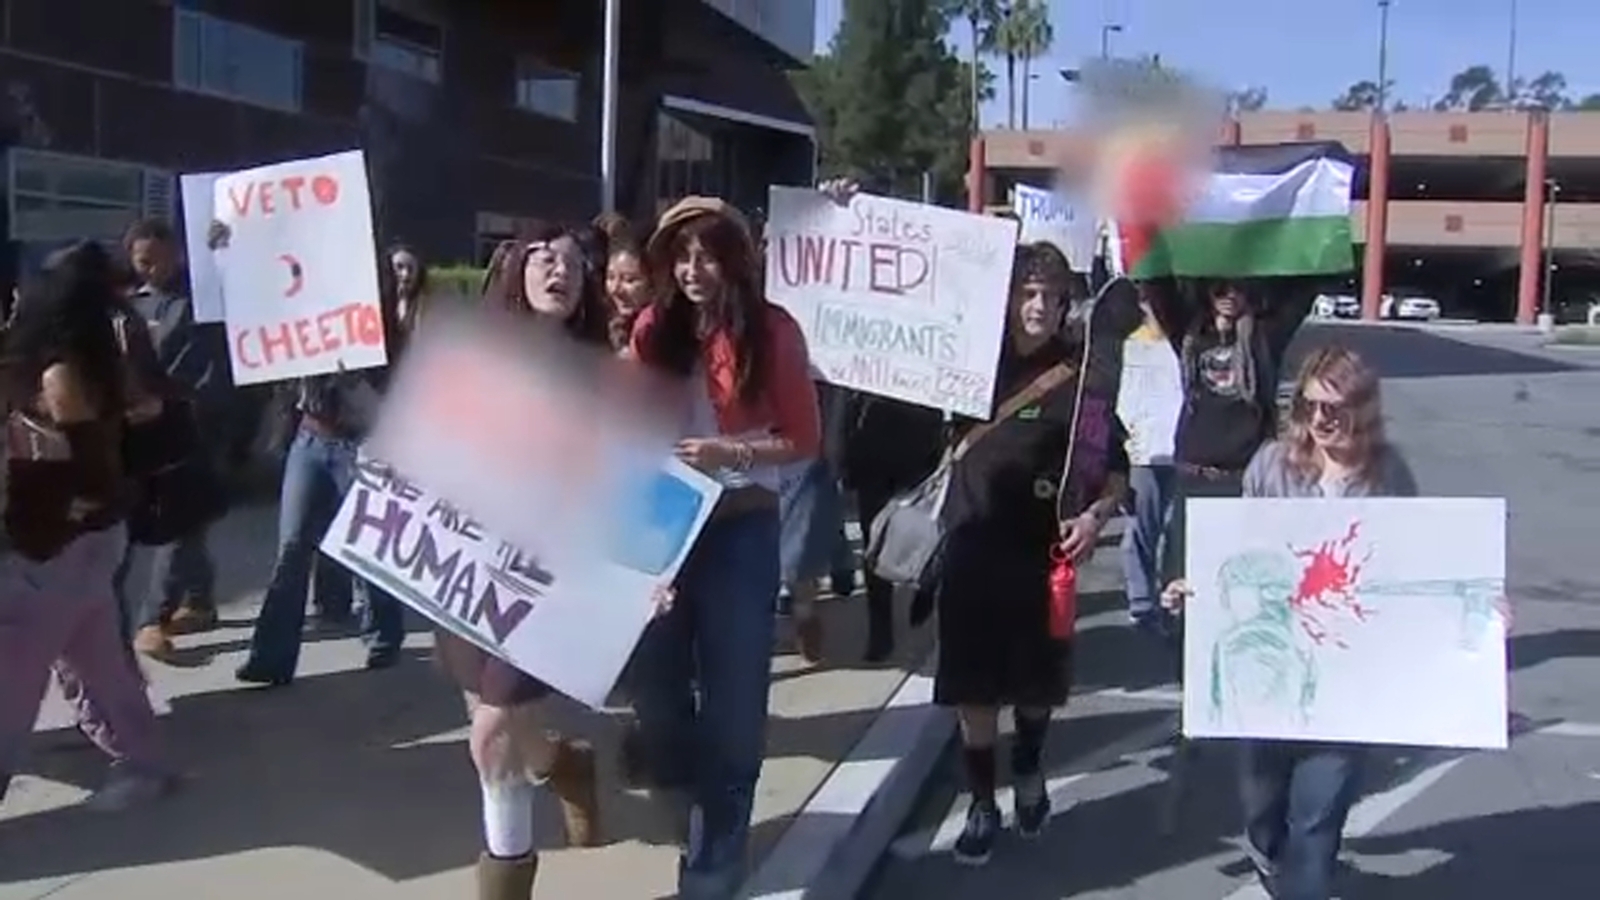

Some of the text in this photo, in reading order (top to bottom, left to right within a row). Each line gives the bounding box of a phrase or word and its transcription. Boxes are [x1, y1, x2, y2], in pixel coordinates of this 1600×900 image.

[229, 175, 338, 216] VETO
[853, 203, 932, 241] States
[779, 234, 929, 295] UNITED
[237, 302, 381, 368] CHEETO
[346, 489, 535, 645] HUMAN
